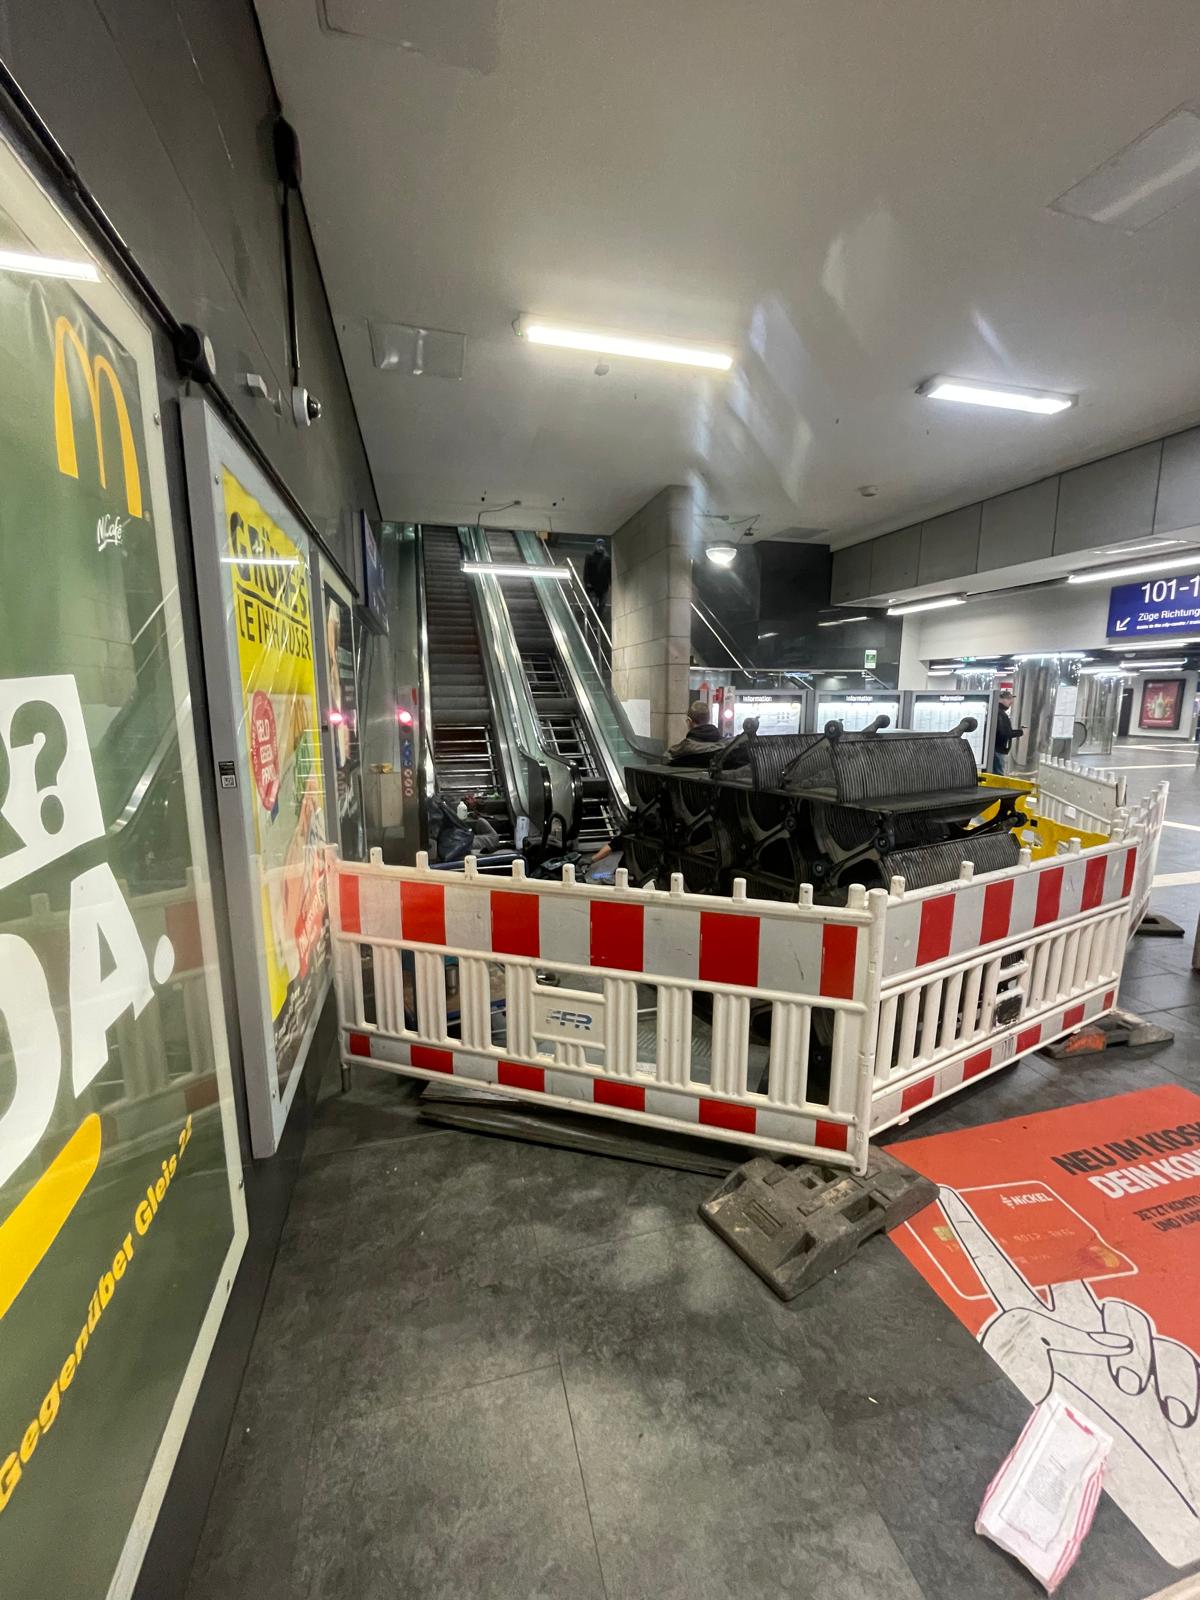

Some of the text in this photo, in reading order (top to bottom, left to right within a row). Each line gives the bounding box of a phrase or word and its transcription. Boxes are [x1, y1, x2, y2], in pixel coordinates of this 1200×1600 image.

[1138, 613, 1159, 622] Züge
[1051, 1147, 1117, 1176] NEU
[1104, 1138, 1154, 1163] IM
[1087, 1164, 1171, 1199] DEIN
[0, 1231, 134, 1514] Gegenüber
[134, 1153, 177, 1236] Gleis
